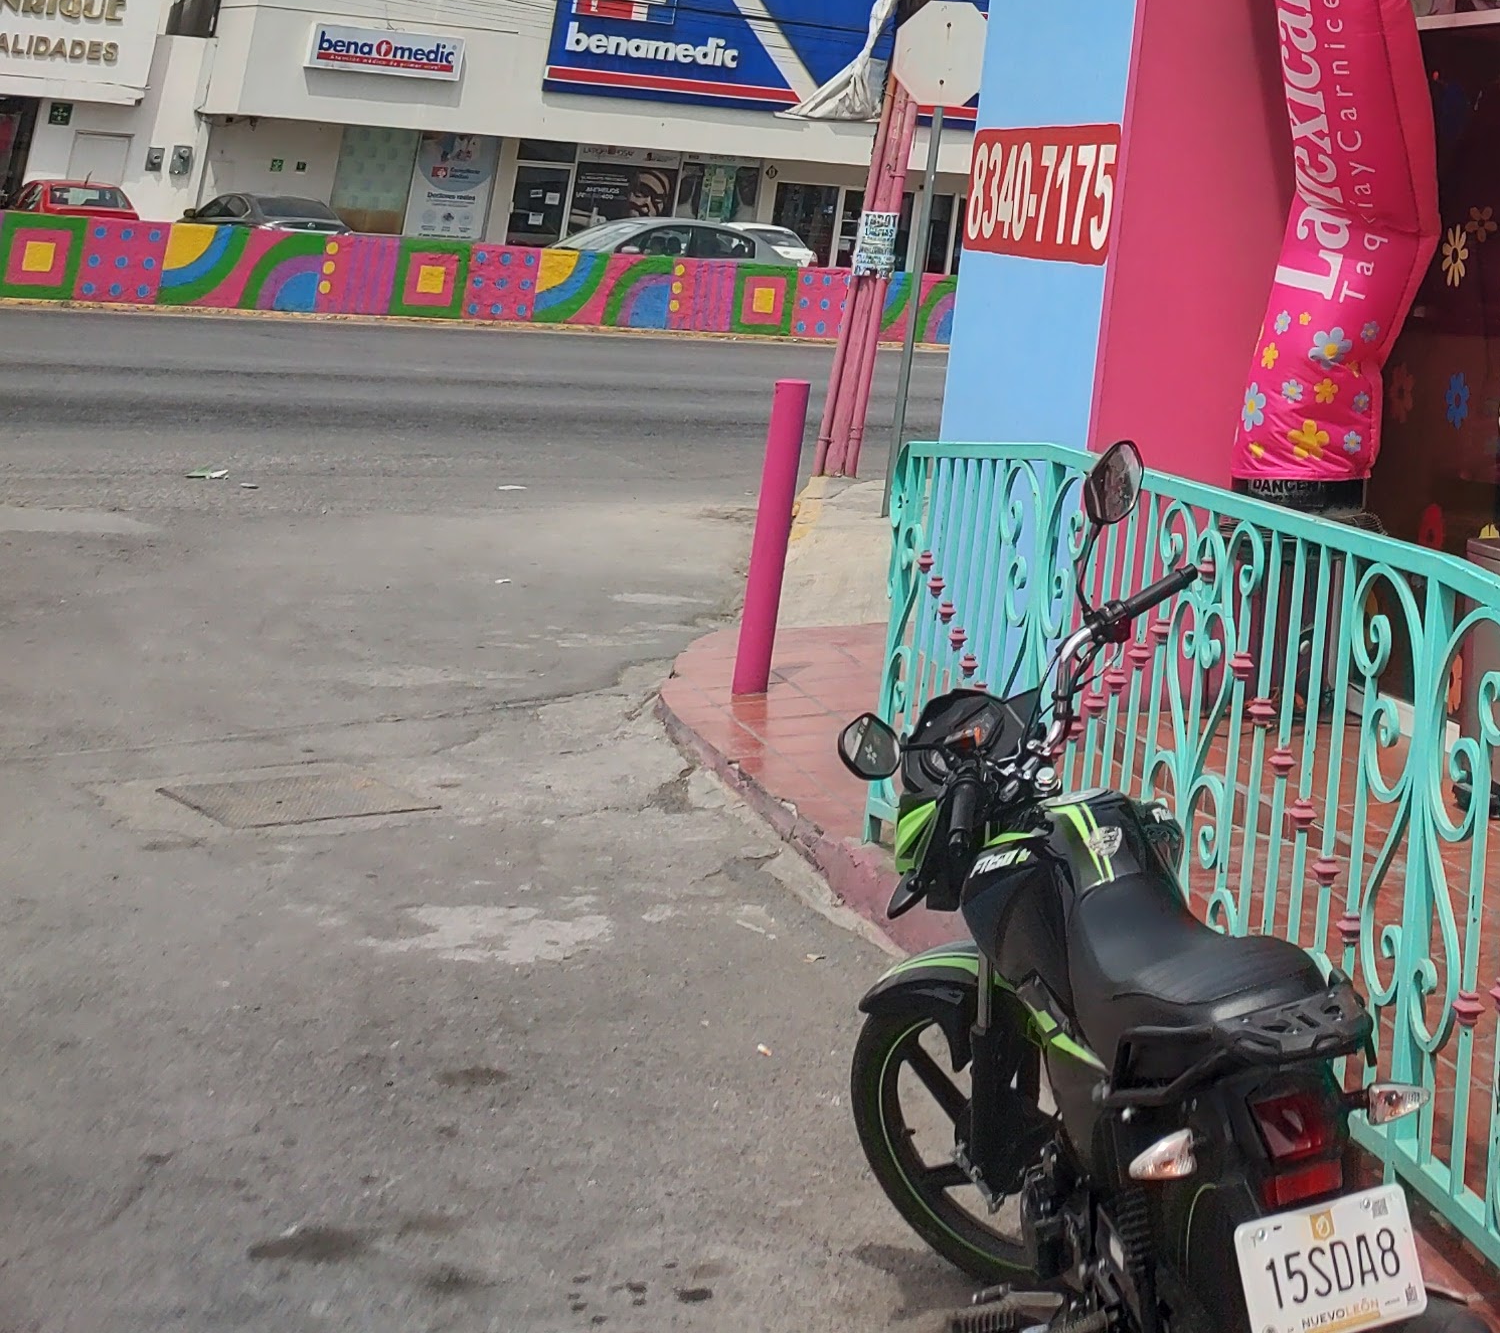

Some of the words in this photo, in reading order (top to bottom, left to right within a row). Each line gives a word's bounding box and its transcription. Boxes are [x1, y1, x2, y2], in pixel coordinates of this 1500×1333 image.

[565, 21, 739, 69] benamedic
[967, 141, 1117, 251] 8340-7175
[1275, 206, 1351, 300] La
[1265, 1227, 1400, 1310] 15SDA8
